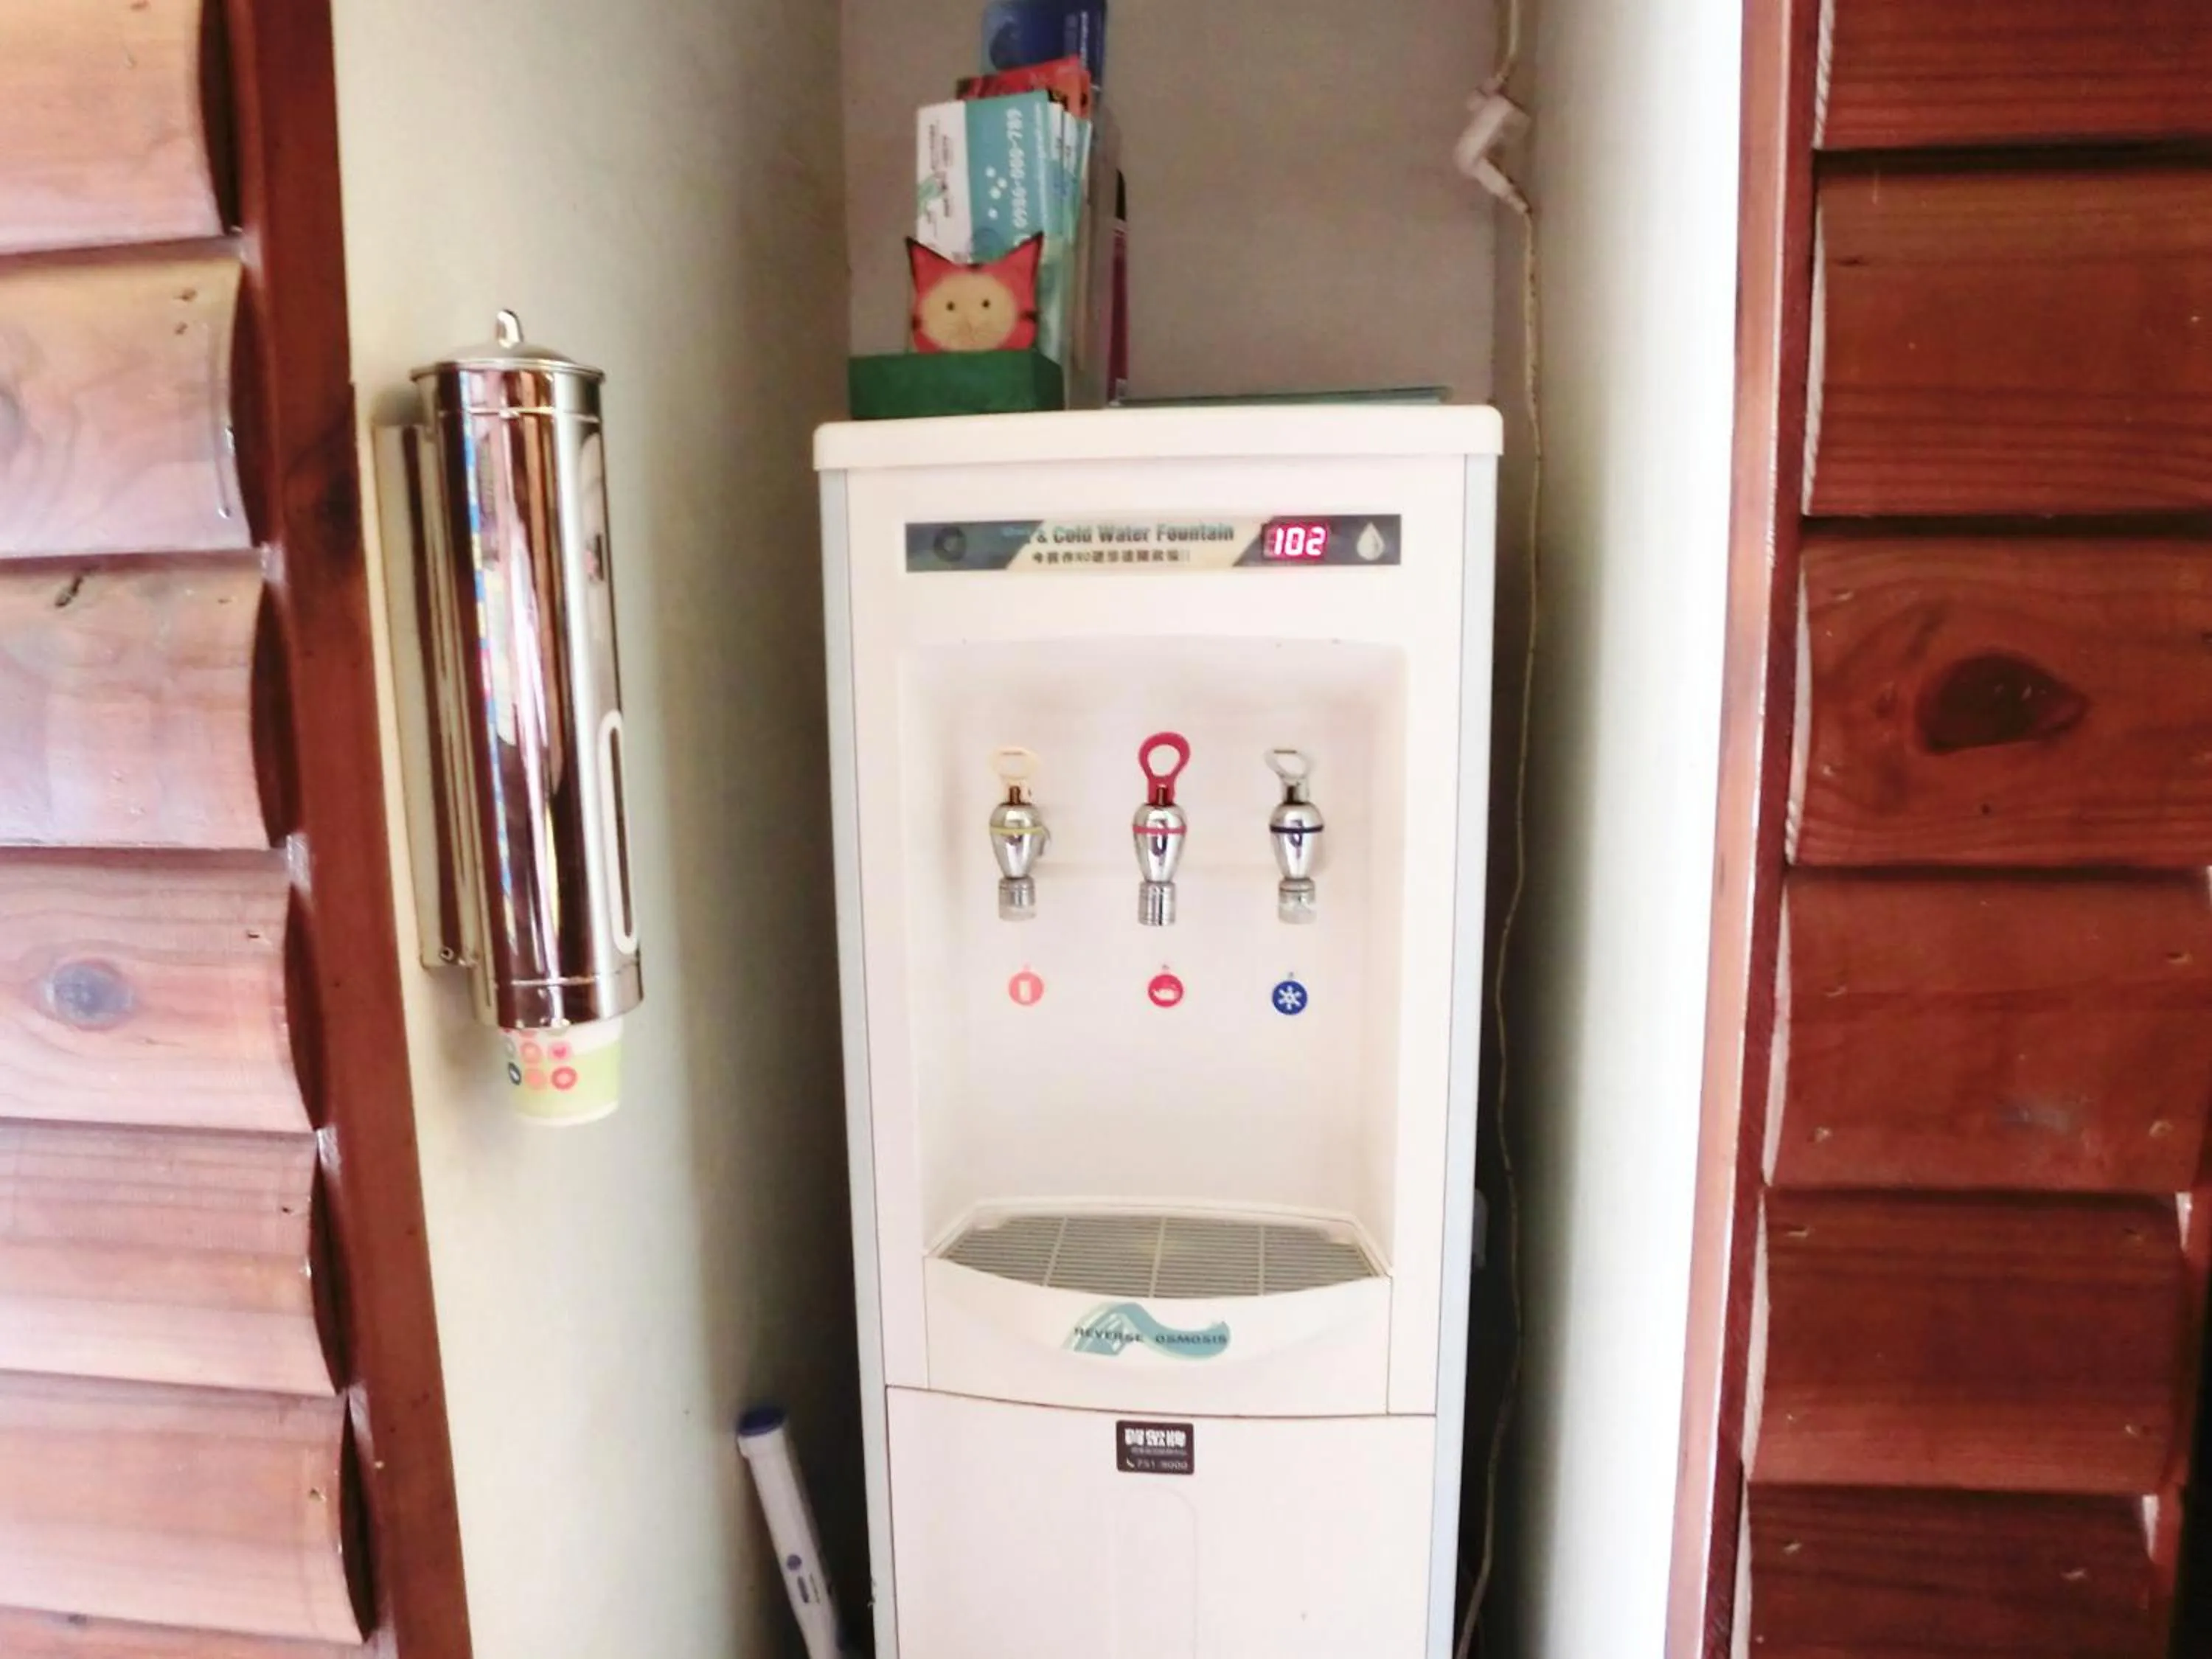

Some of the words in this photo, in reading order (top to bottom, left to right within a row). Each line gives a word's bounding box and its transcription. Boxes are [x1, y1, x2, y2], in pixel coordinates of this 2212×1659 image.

[1053, 525, 1093, 543] Cold
[1098, 524, 1150, 543] Water
[1155, 523, 1234, 542] Fountain
[1274, 526, 1326, 555] 102
[1074, 1327, 1144, 1343] REVERSE
[1155, 1333, 1228, 1346] OSMOSIS
